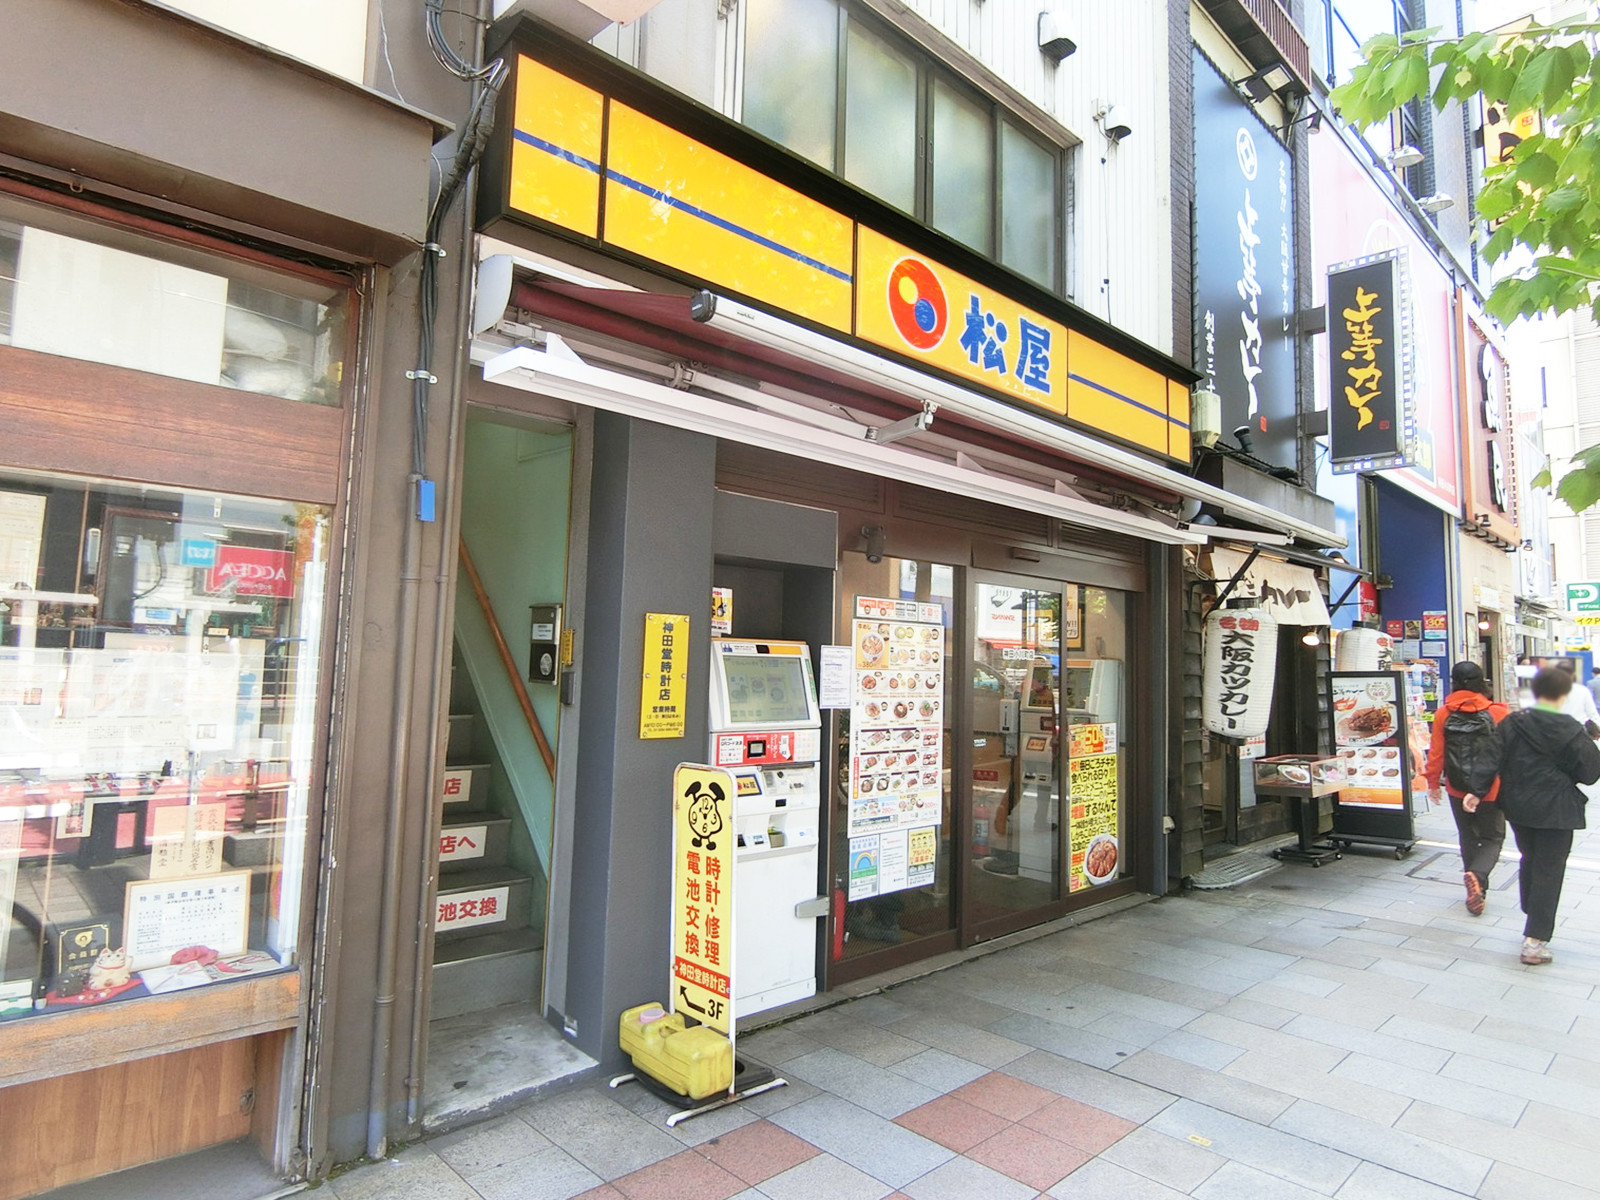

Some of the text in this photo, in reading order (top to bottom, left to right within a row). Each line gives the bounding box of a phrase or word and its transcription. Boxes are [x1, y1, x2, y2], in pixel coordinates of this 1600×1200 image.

[960, 294, 1052, 394] 松屋
[658, 621, 675, 701] 神田堂時計店
[1219, 630, 1256, 730] 大阪カツカレー
[652, 705, 677, 713] 営業時間
[444, 778, 462, 795] 店
[439, 835, 477, 854] 店へ
[437, 896, 498, 923] 池交換
[685, 850, 701, 957] 電池交換
[704, 856, 721, 966] 時計・修理
[679, 962, 726, 995] 神田堂時計店
[707, 999, 724, 1020] 3F
